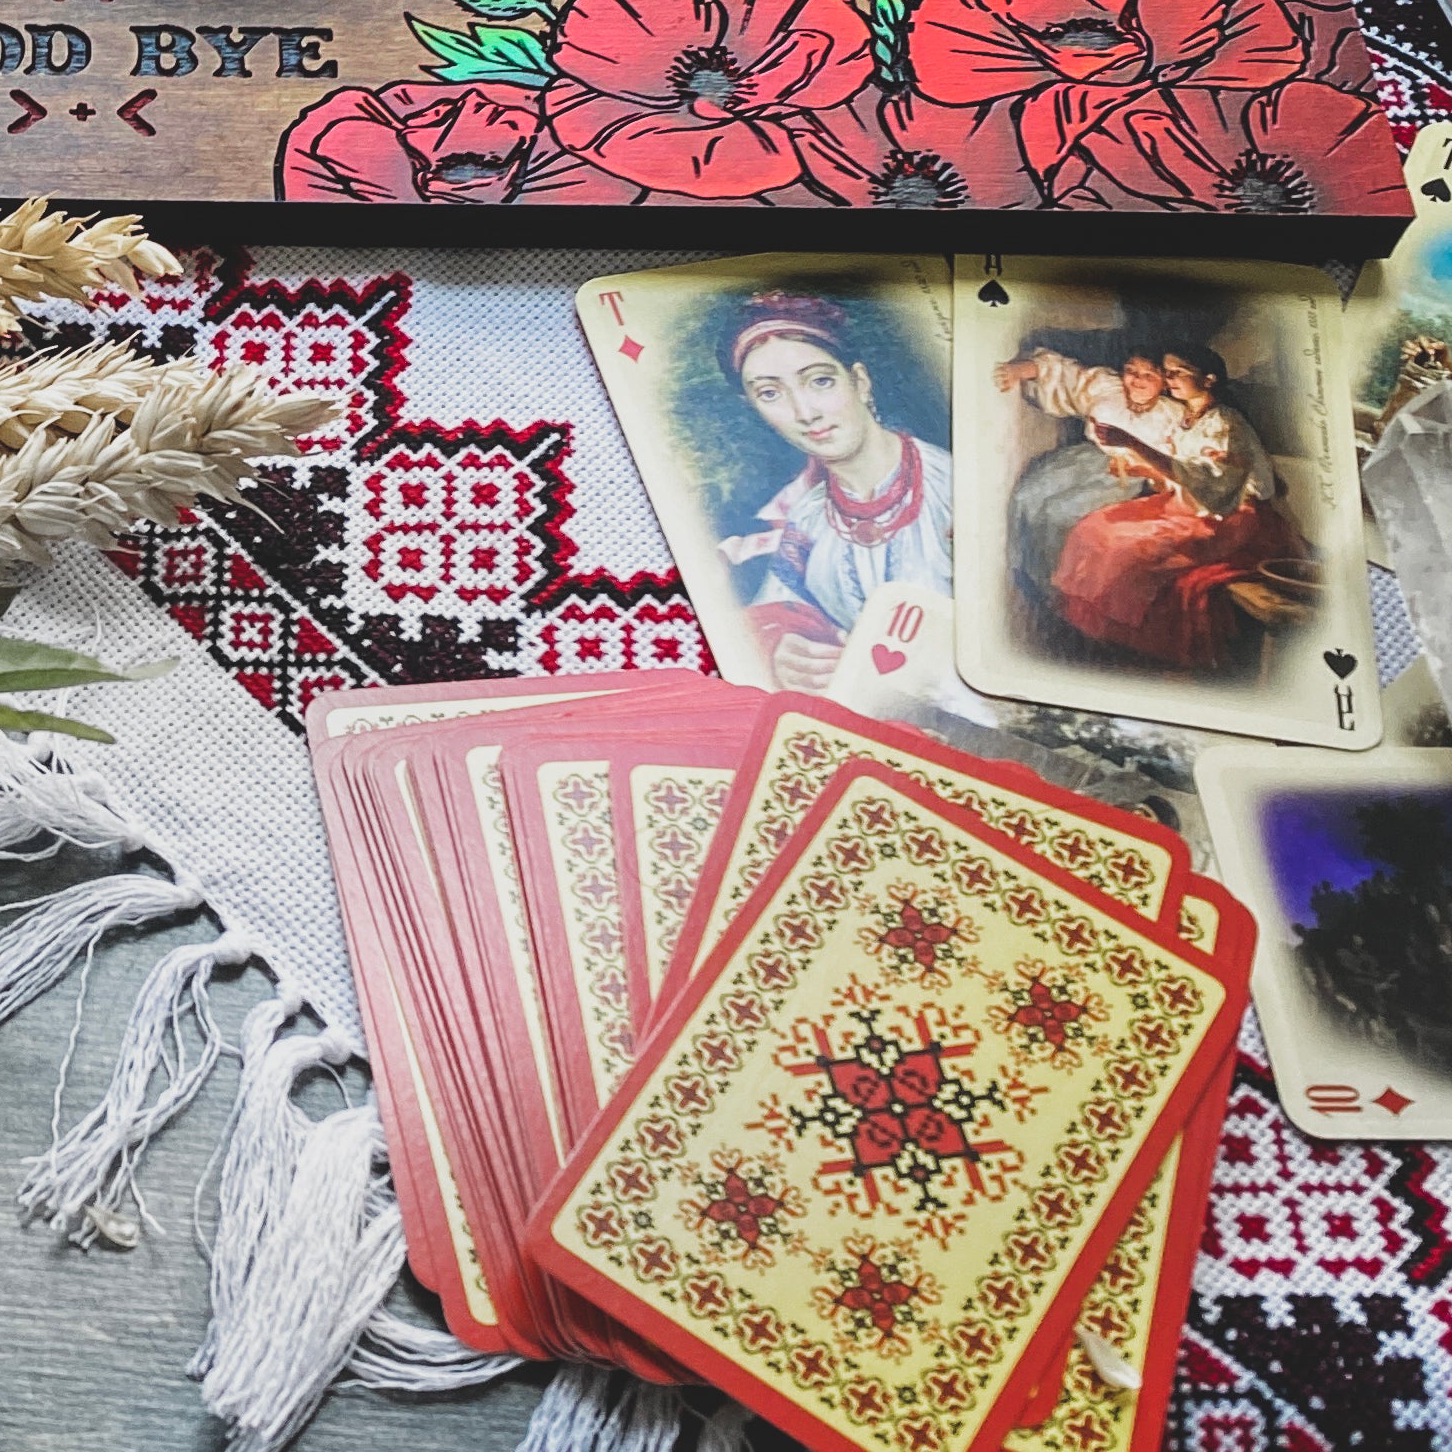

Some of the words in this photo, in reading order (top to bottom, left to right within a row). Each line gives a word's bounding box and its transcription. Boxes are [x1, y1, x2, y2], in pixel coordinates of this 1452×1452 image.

[128, 23, 340, 79] BYE
[886, 600, 925, 644] 10
[1304, 1083, 1364, 1119] 10
